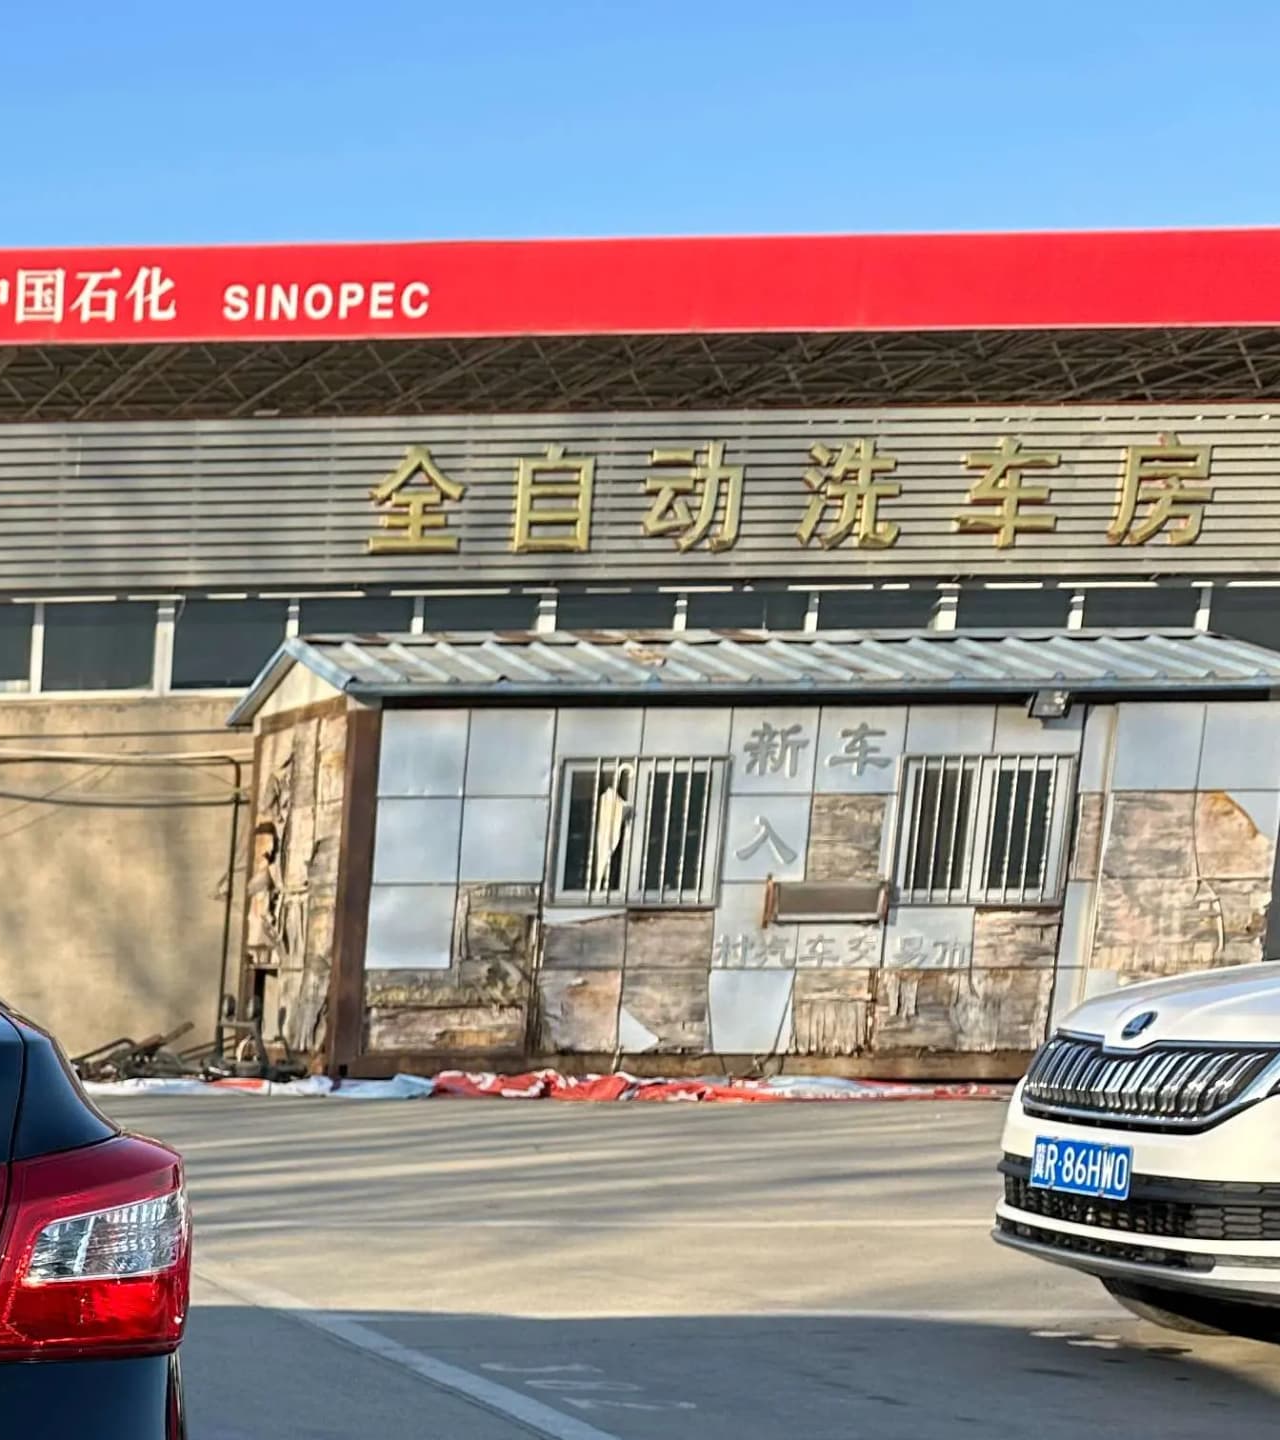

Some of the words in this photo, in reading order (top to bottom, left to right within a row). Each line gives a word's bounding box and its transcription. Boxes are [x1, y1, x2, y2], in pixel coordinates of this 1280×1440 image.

[223, 281, 431, 322] SINOPEC
[366, 431, 1214, 554] 全自动洗车房
[743, 721, 892, 778] 新车
[734, 815, 798, 864] 入
